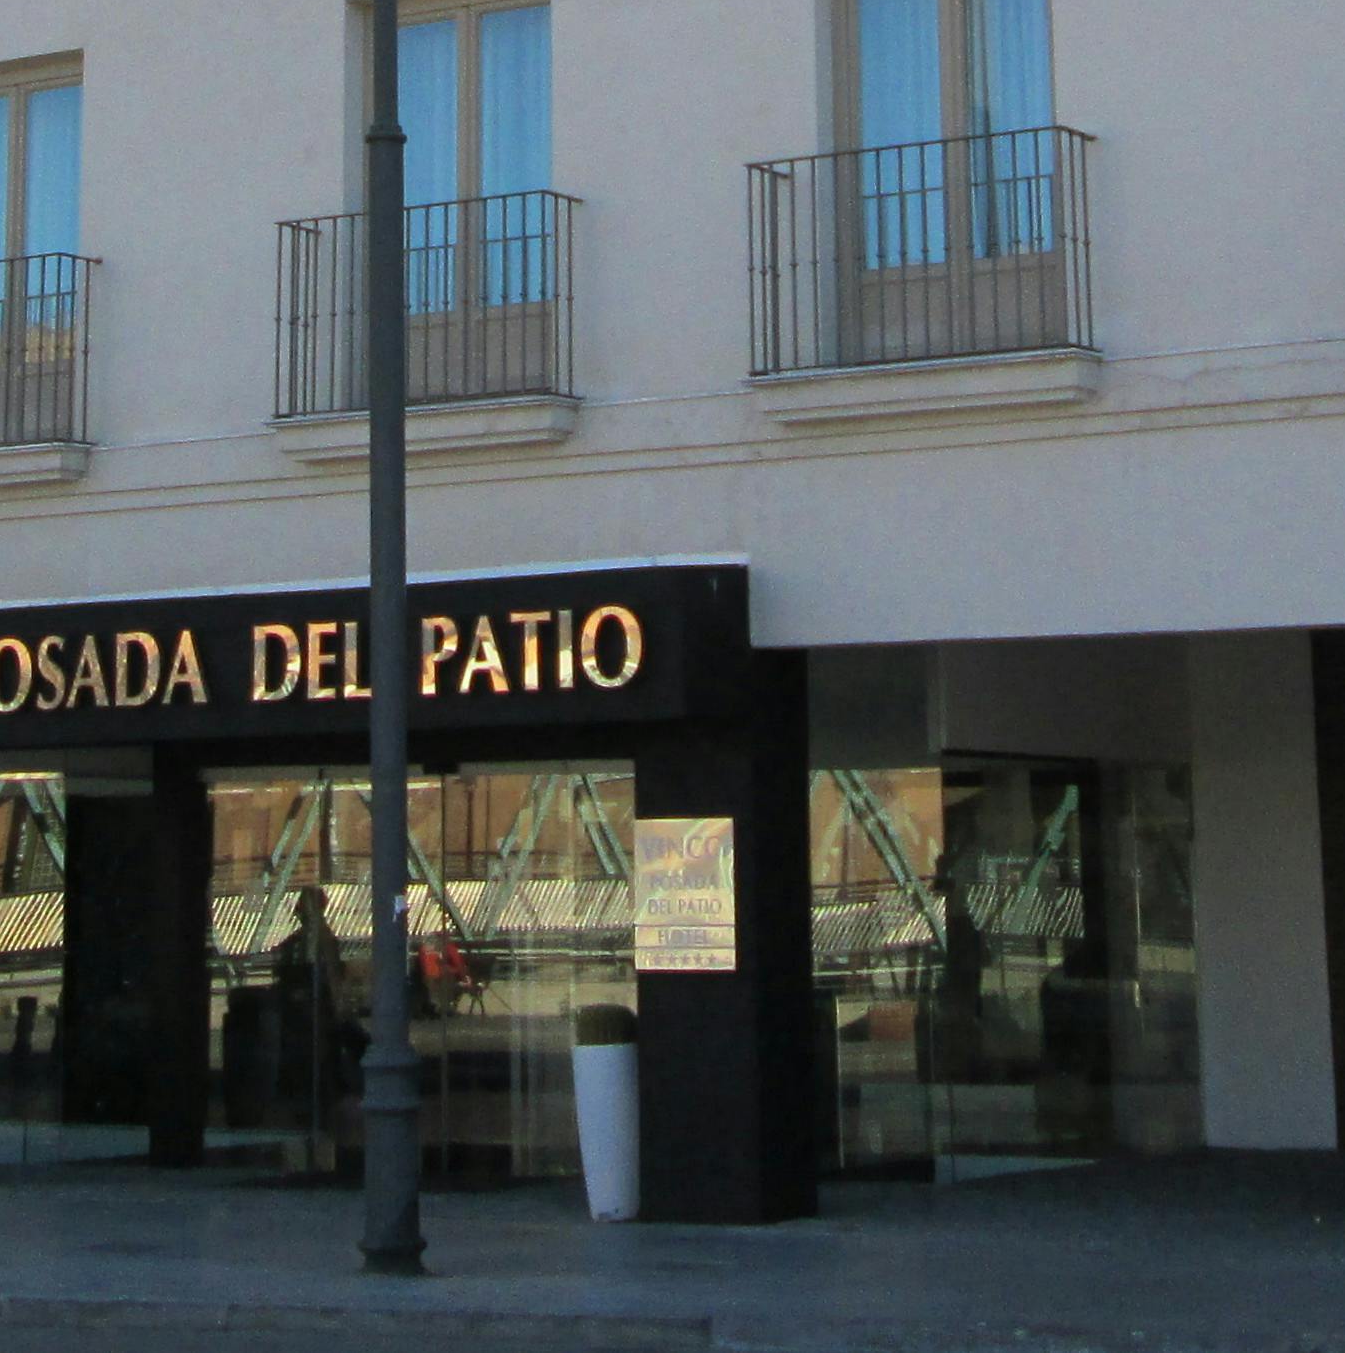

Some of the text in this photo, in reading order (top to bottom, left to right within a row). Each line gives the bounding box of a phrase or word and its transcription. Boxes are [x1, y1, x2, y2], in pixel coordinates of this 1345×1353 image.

[252, 621, 372, 702] DEL
[421, 605, 643, 696] PATIO
[648, 898, 722, 915] DEL PATIO
[658, 929, 709, 945] HOTEL
